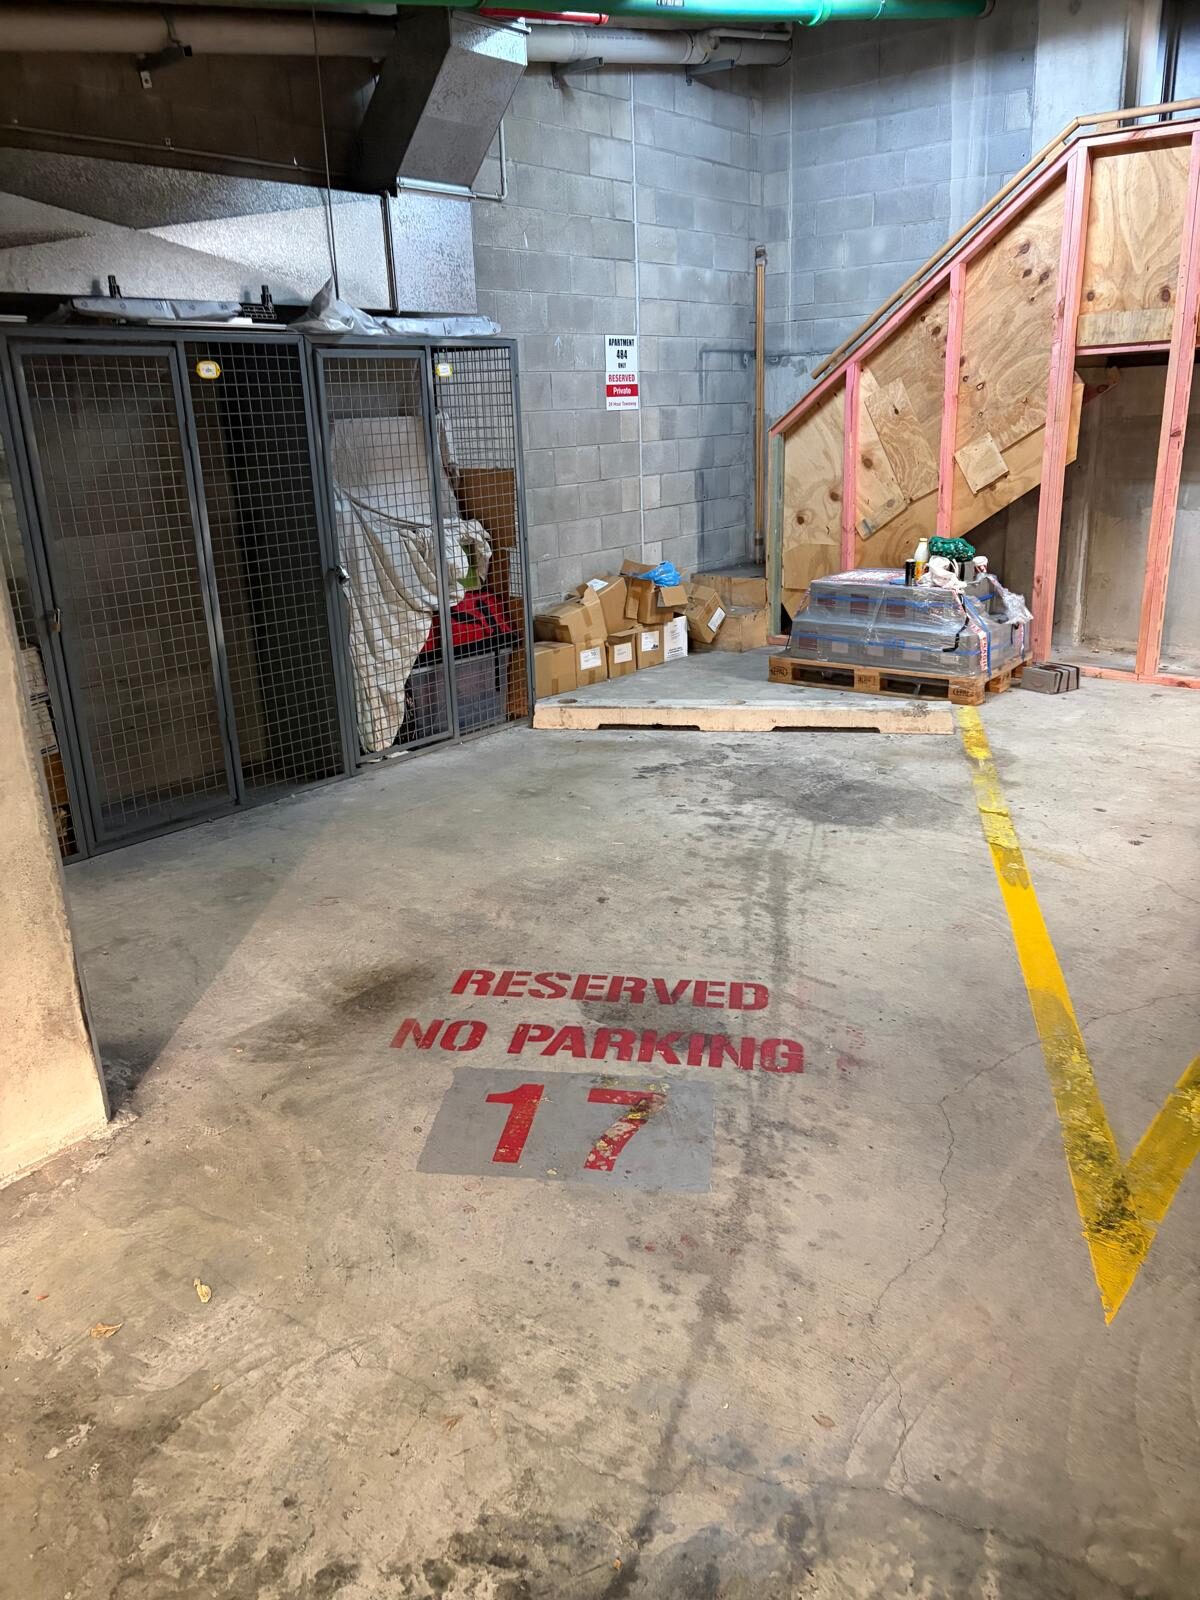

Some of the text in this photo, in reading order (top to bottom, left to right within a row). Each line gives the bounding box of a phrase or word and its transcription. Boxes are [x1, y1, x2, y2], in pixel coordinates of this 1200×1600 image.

[608, 338, 634, 347] APARTMENT
[608, 374, 635, 383] RESERVED
[613, 387, 631, 395] Private
[450, 969, 770, 1011] RESERVED
[389, 1018, 805, 1074] NO PARKING
[485, 1083, 667, 1171] 17
